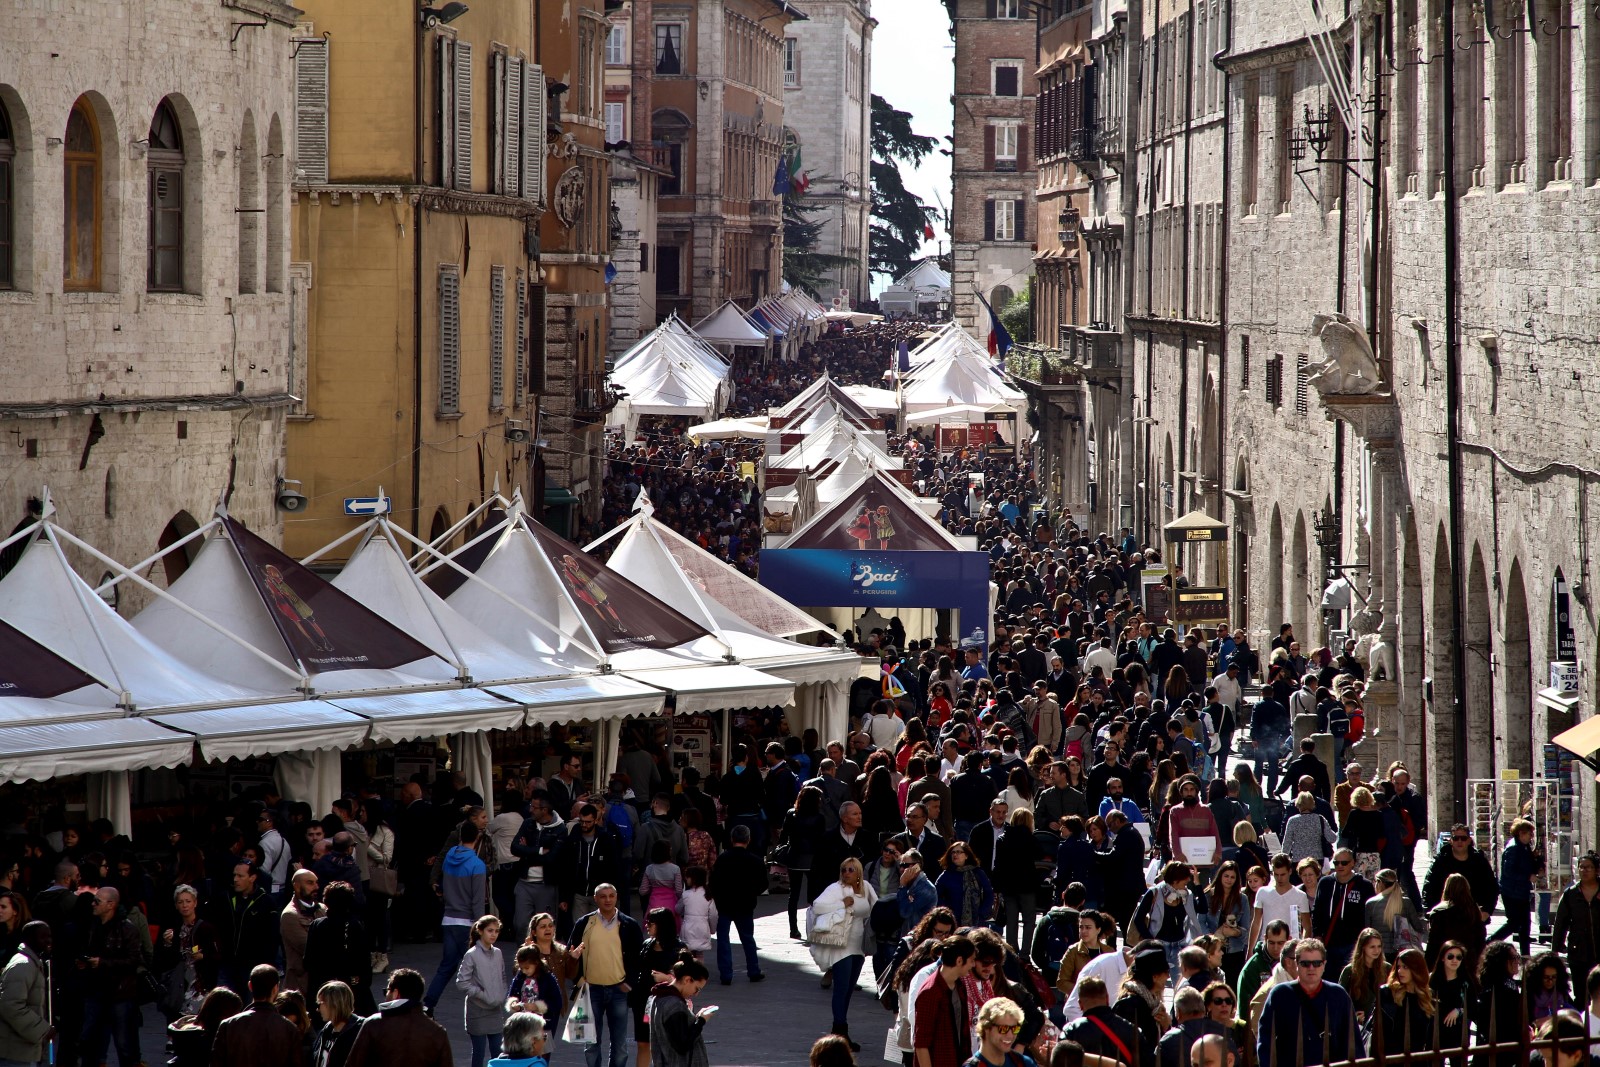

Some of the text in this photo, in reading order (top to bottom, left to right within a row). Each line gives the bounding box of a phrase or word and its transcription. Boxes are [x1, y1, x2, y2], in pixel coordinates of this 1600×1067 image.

[853, 564, 899, 587] Baci
[1561, 640, 1575, 648] TABA
[1564, 681, 1578, 691] 24
